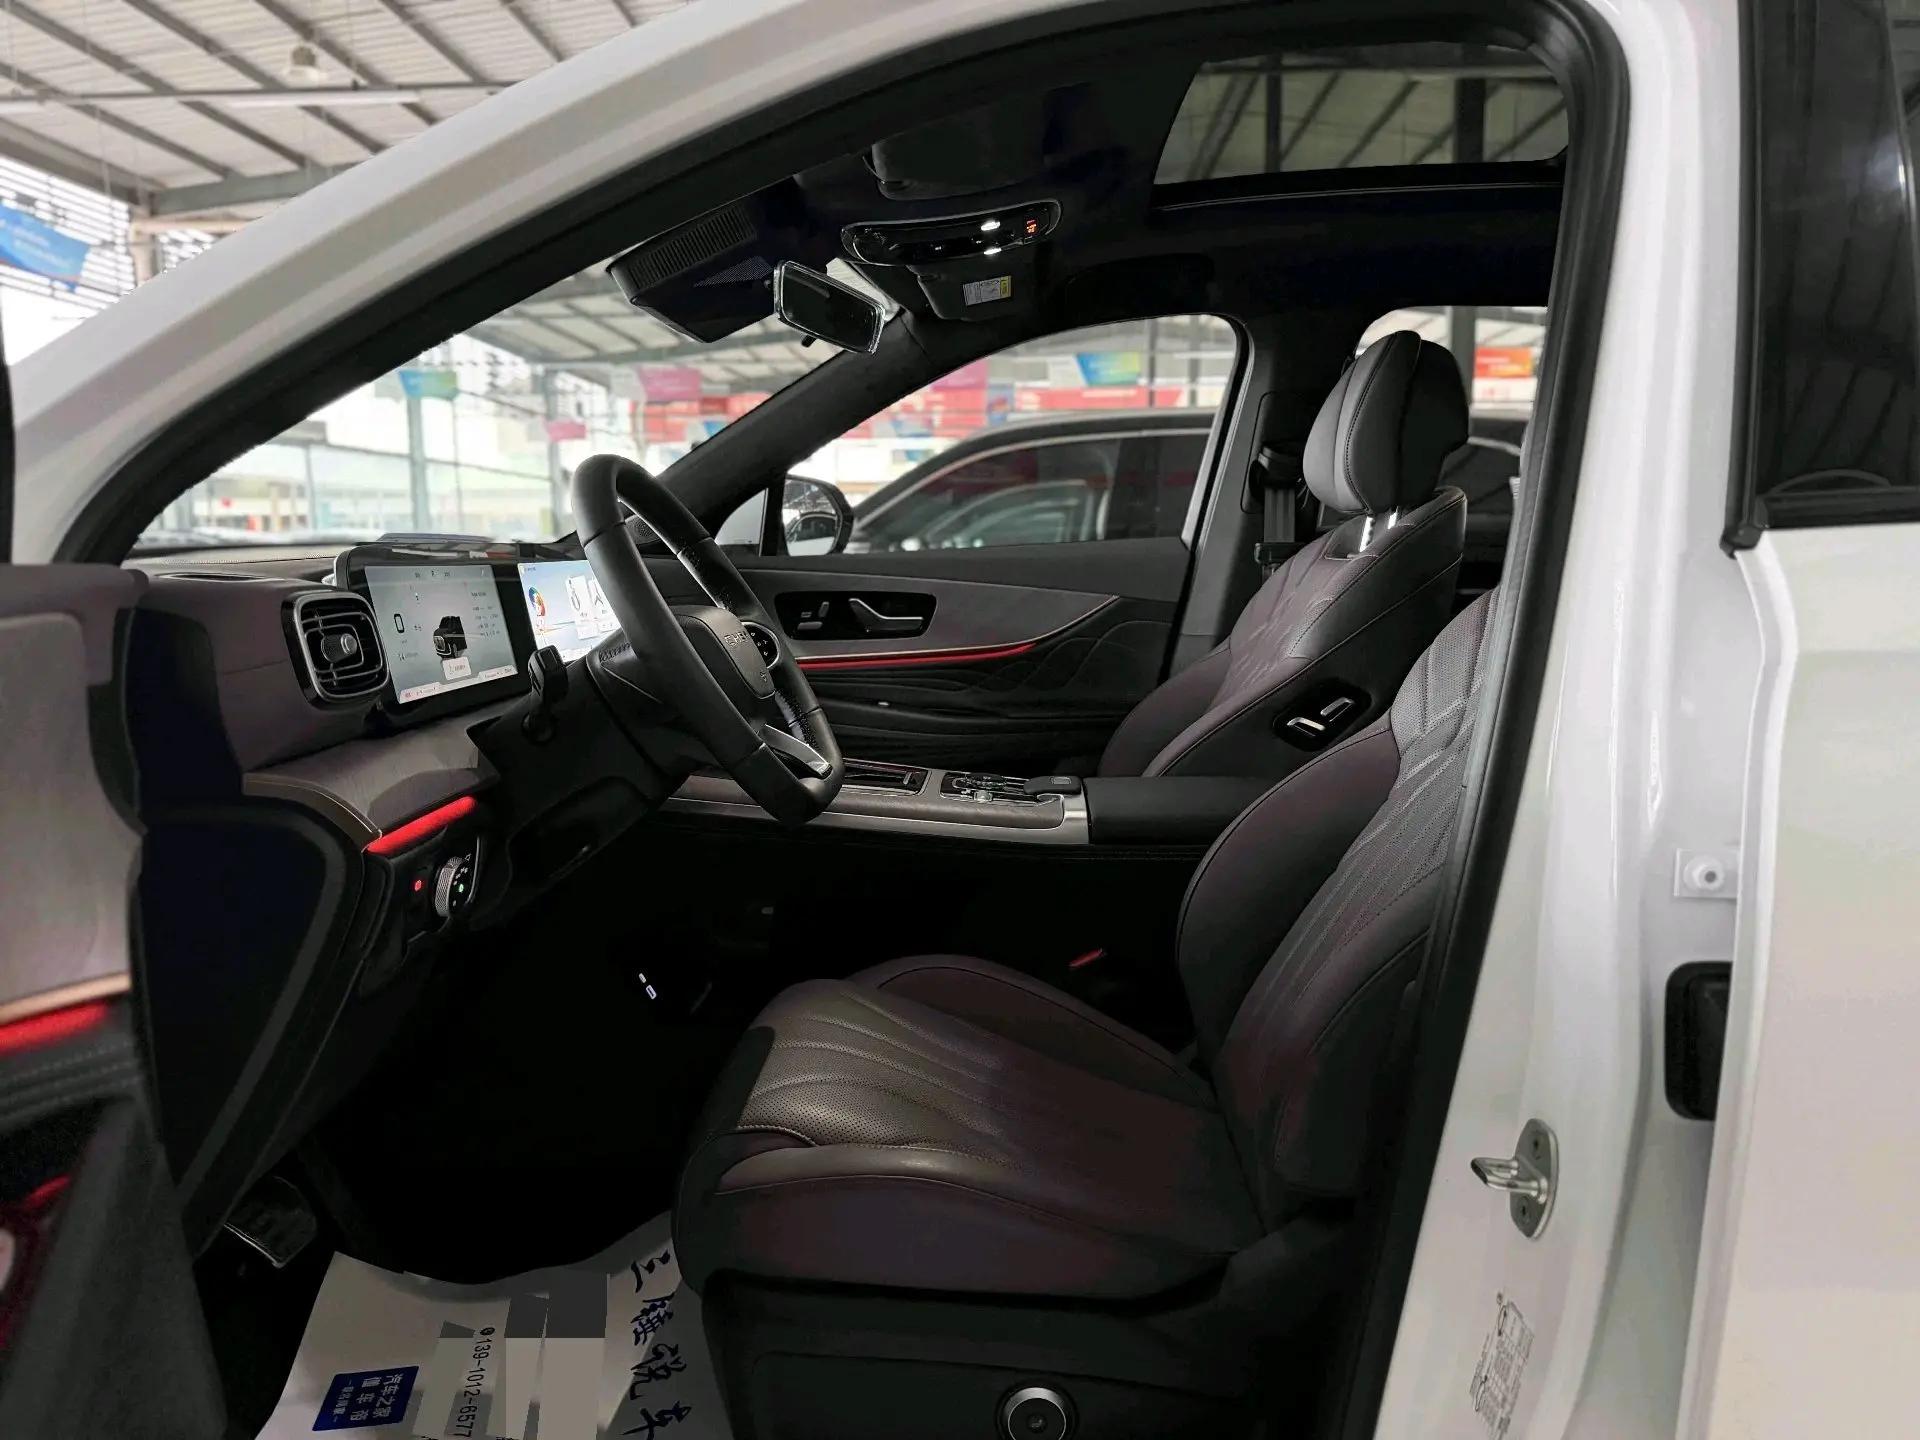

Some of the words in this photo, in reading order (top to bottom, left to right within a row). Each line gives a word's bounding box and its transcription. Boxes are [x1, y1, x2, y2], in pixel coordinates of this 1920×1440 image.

[372, 1373, 404, 1429] 汽车之家
[453, 1338, 492, 1438] 139-1012-6577
